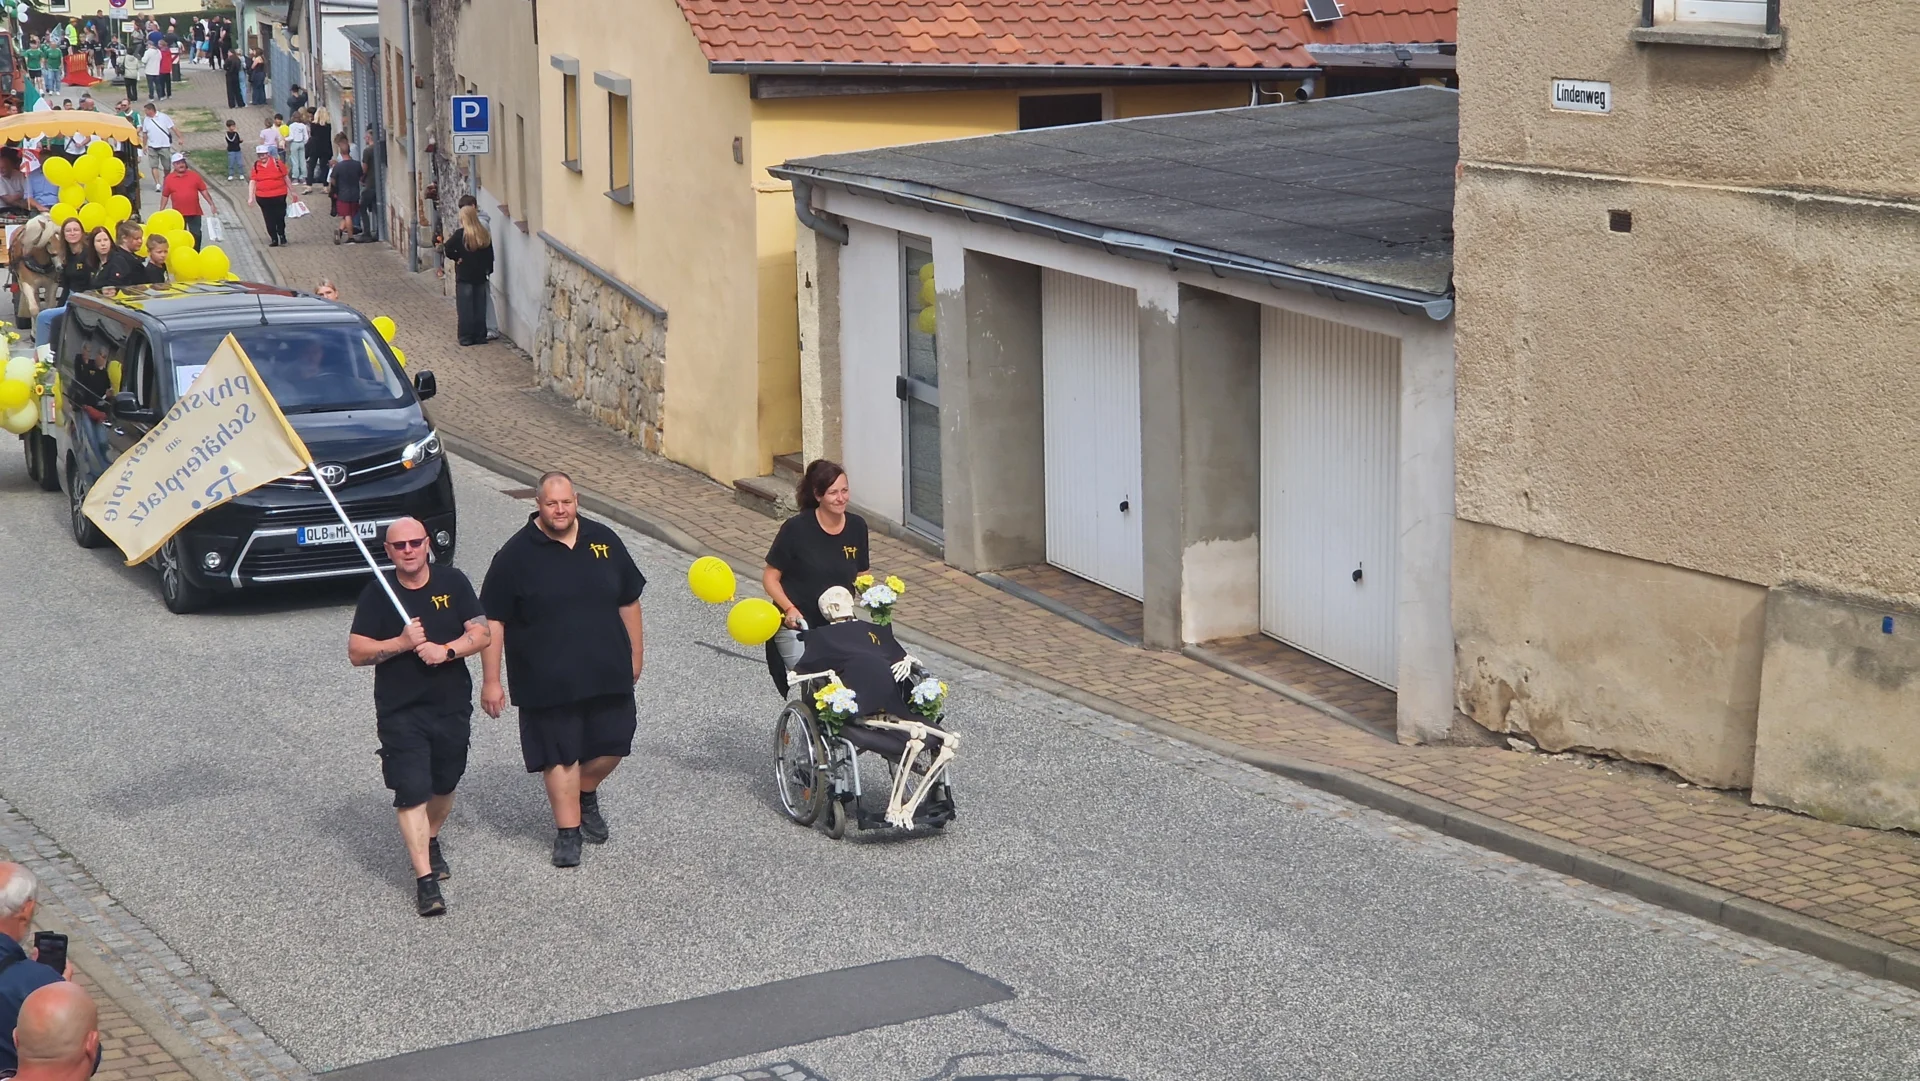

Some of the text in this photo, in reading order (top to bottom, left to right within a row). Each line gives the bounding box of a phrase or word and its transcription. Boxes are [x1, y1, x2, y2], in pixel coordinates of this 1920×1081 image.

[1556, 83, 1606, 110] Lindenweg
[461, 101, 480, 128] P
[306, 527, 329, 541] QLB
[353, 523, 374, 536] 144
